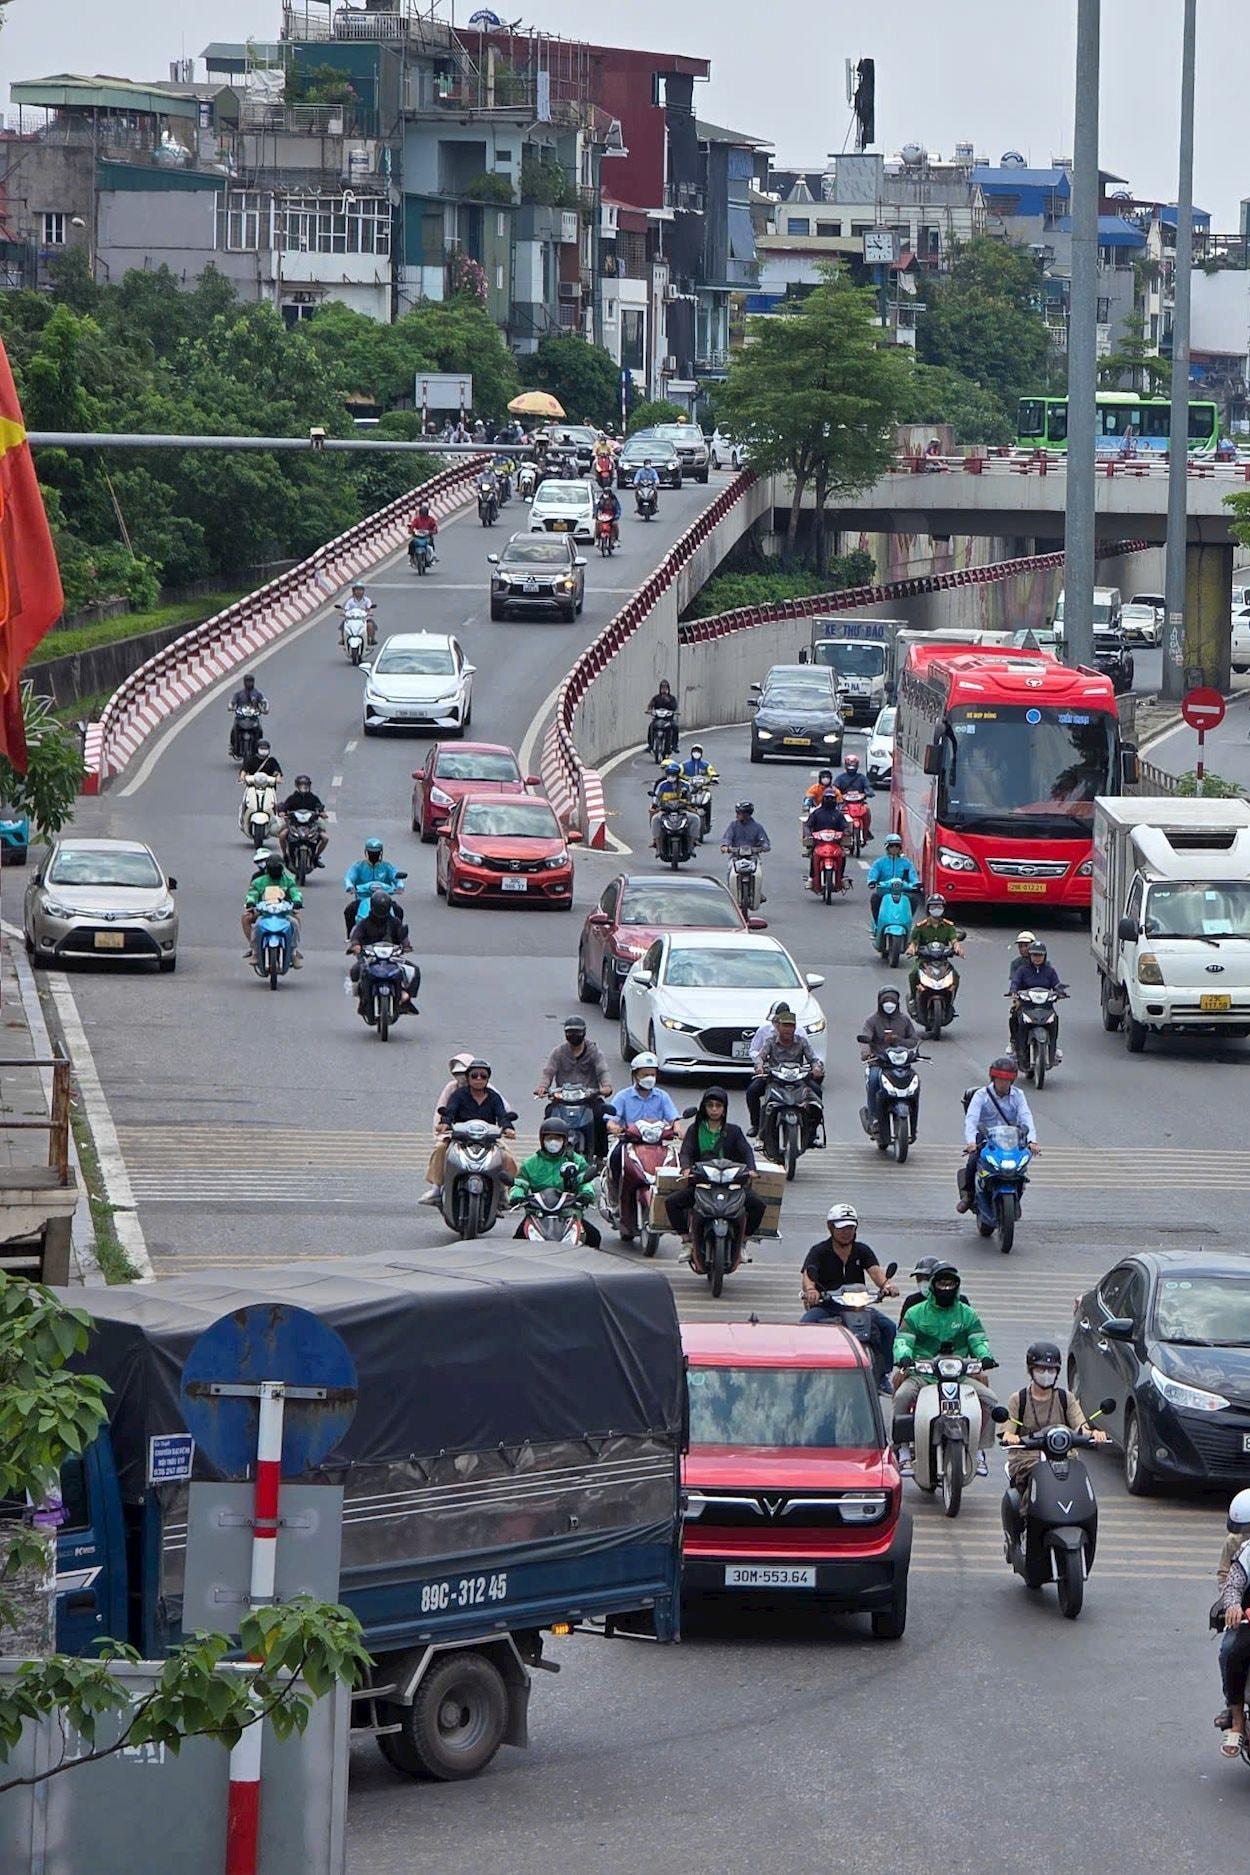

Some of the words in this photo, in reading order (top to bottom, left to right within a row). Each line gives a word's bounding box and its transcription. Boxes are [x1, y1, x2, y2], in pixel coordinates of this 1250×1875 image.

[824, 624, 836, 636] XE
[843, 624, 861, 637] THƯ
[732, 1570, 809, 1584] 30M-553.64
